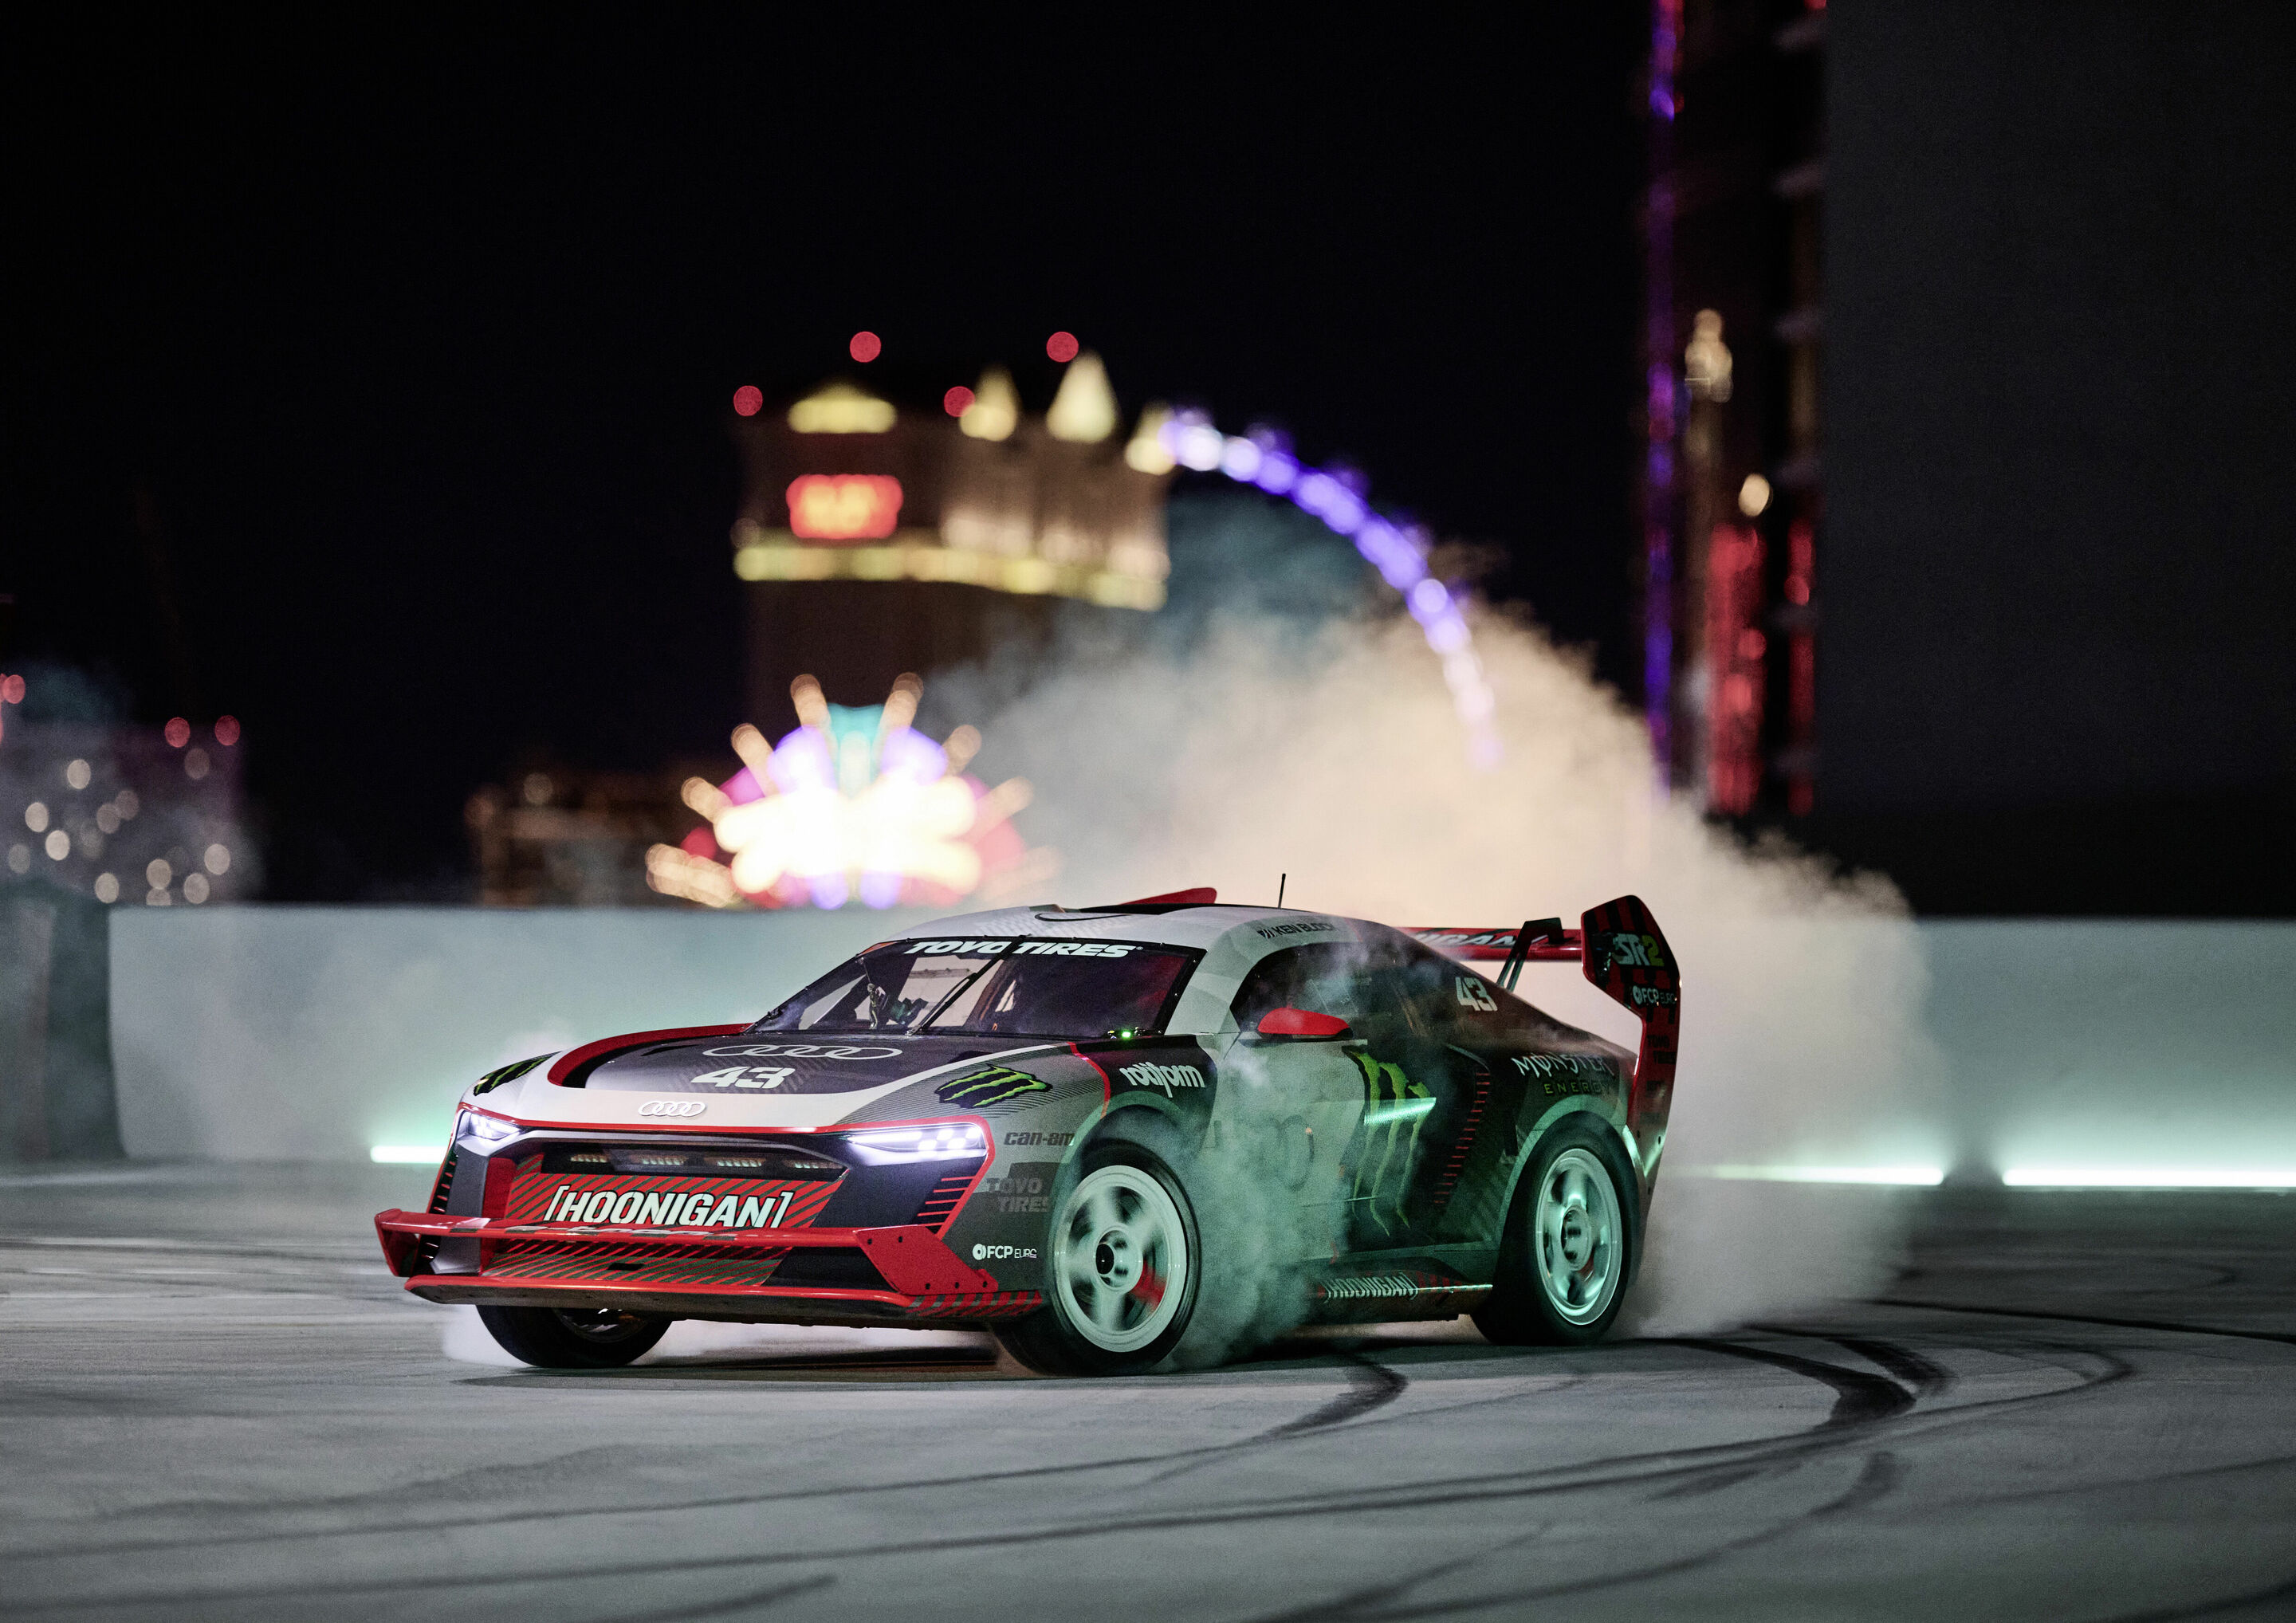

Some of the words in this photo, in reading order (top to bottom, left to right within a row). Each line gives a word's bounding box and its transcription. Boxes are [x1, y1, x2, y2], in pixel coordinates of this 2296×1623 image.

[1272, 923, 1302, 936] KEN
[903, 941, 1012, 955] TOYO
[1012, 941, 1136, 957] TIRES
[1455, 977, 1498, 1012] 43
[1641, 987, 1660, 1004] FCP
[690, 1066, 796, 1089] 43
[1004, 1132, 1075, 1146] can-am
[986, 1177, 1044, 1194] TOYO
[987, 1245, 1013, 1259] FCP
